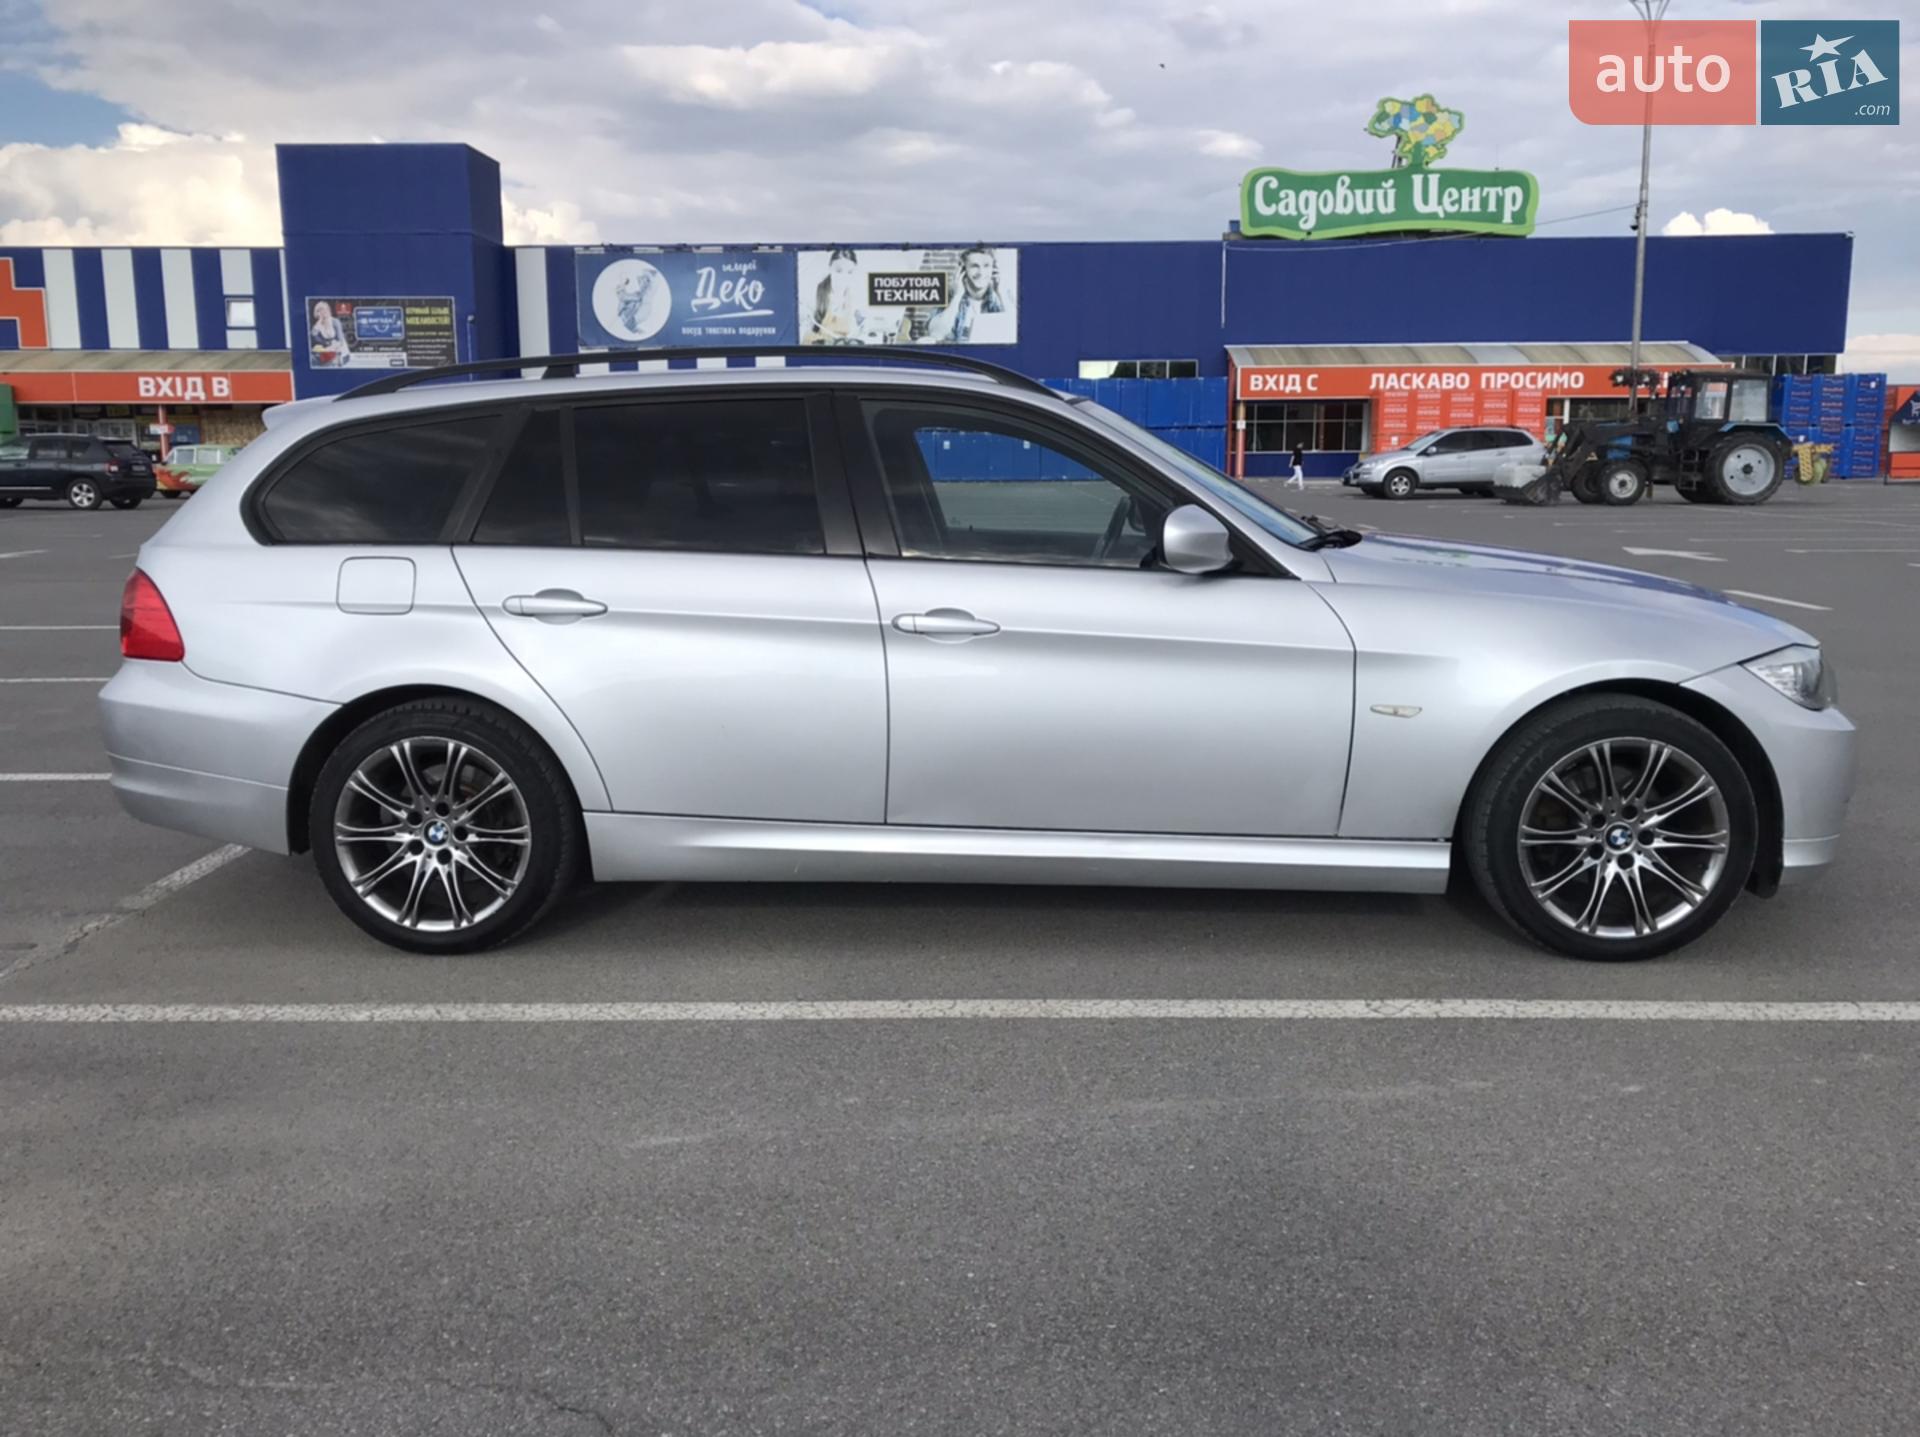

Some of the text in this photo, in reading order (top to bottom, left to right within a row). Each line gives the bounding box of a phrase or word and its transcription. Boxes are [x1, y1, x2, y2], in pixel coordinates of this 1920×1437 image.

[1253, 173, 1524, 231] Садовий Центр
[690, 266, 766, 313] Деко
[874, 277, 940, 288] ПОБУТОВА
[875, 289, 940, 302] ТЕХНІКА
[138, 376, 230, 401] ВХІД В
[1249, 374, 1319, 393] ВХІД С
[1369, 371, 1585, 390] ЛАСКАВО ПРОСИМО
